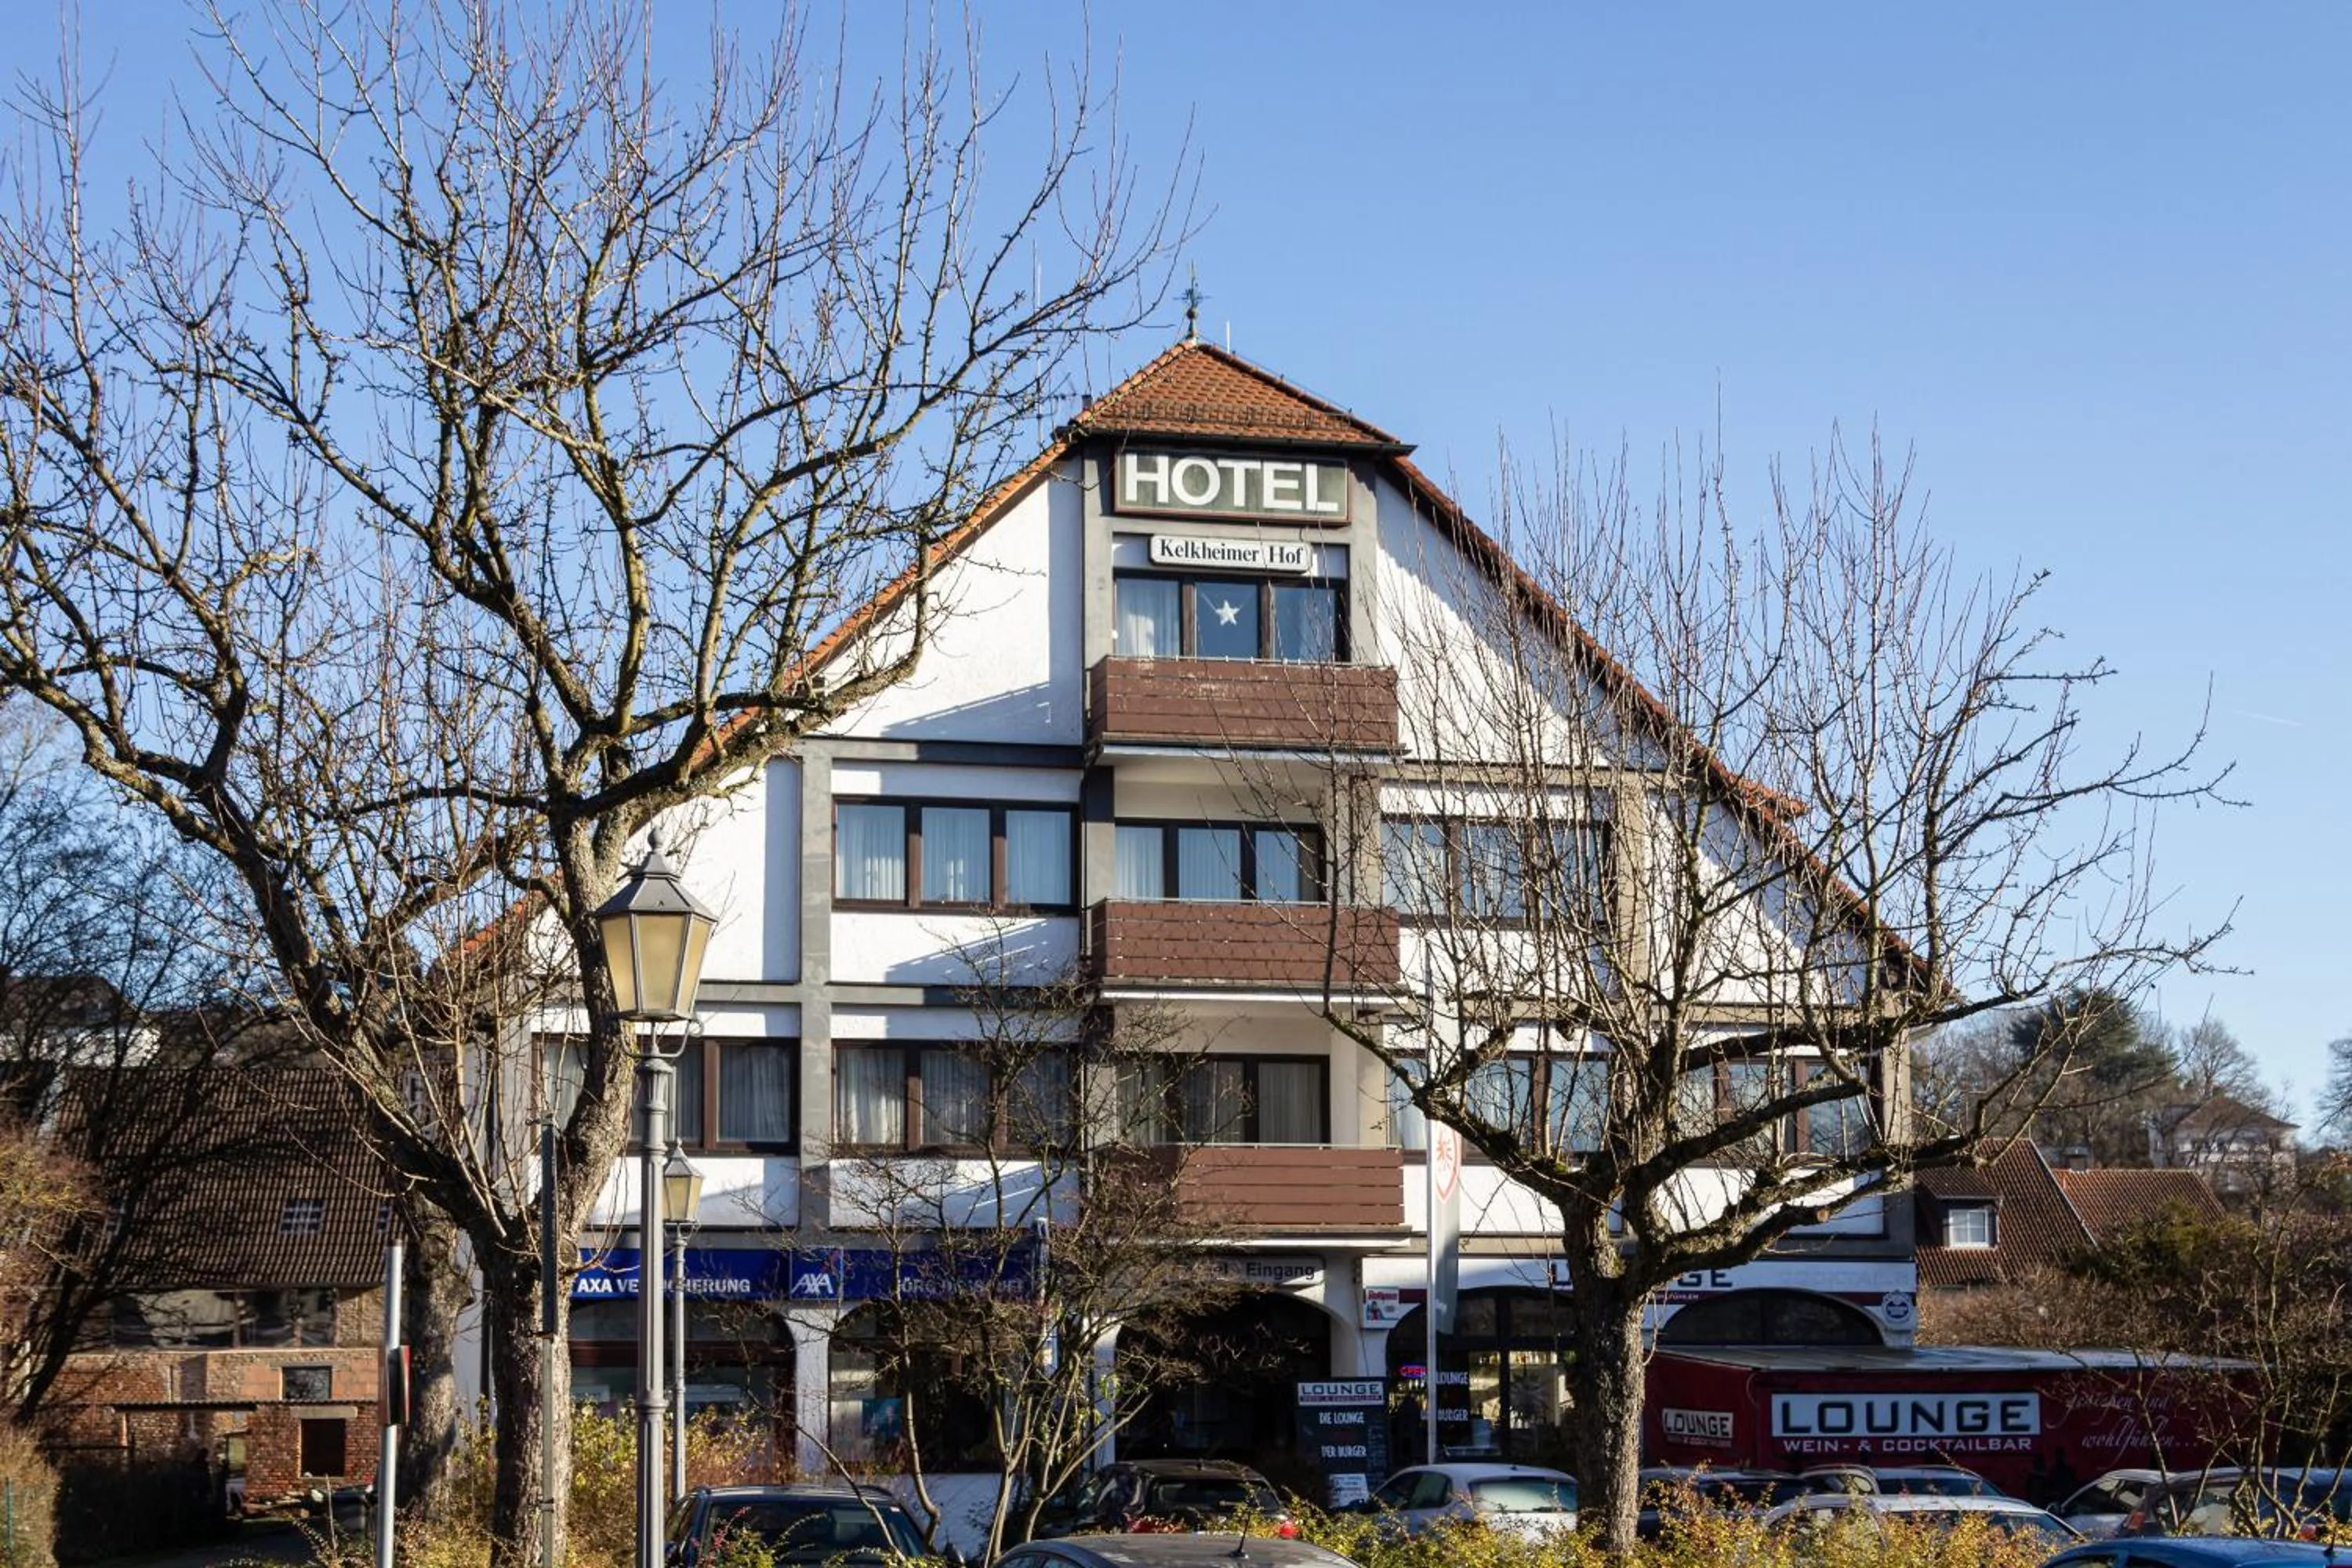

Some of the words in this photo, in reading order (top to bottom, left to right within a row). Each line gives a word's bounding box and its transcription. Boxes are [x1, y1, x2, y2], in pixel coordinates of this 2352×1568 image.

[1125, 453, 1339, 512] HOTEL
[1160, 538, 1260, 562] Kelkheimer
[1269, 546, 1304, 564] Hof
[1247, 1262, 1315, 1279] Eingang
[1550, 1263, 1733, 1287] LGE
[578, 1279, 613, 1293] AXA
[791, 1273, 833, 1294] AXA
[1436, 1373, 1468, 1385] LOUNGE
[1302, 1385, 1379, 1394] LOUNGE
[1334, 1412, 1365, 1425] LOUNGE
[1664, 1413, 1730, 1436] LOUNGE
[1781, 1401, 2031, 1434] LOUNGE
[1858, 1439, 1872, 1451] &
[1882, 1438, 2032, 1451] COCKTAILBAR
